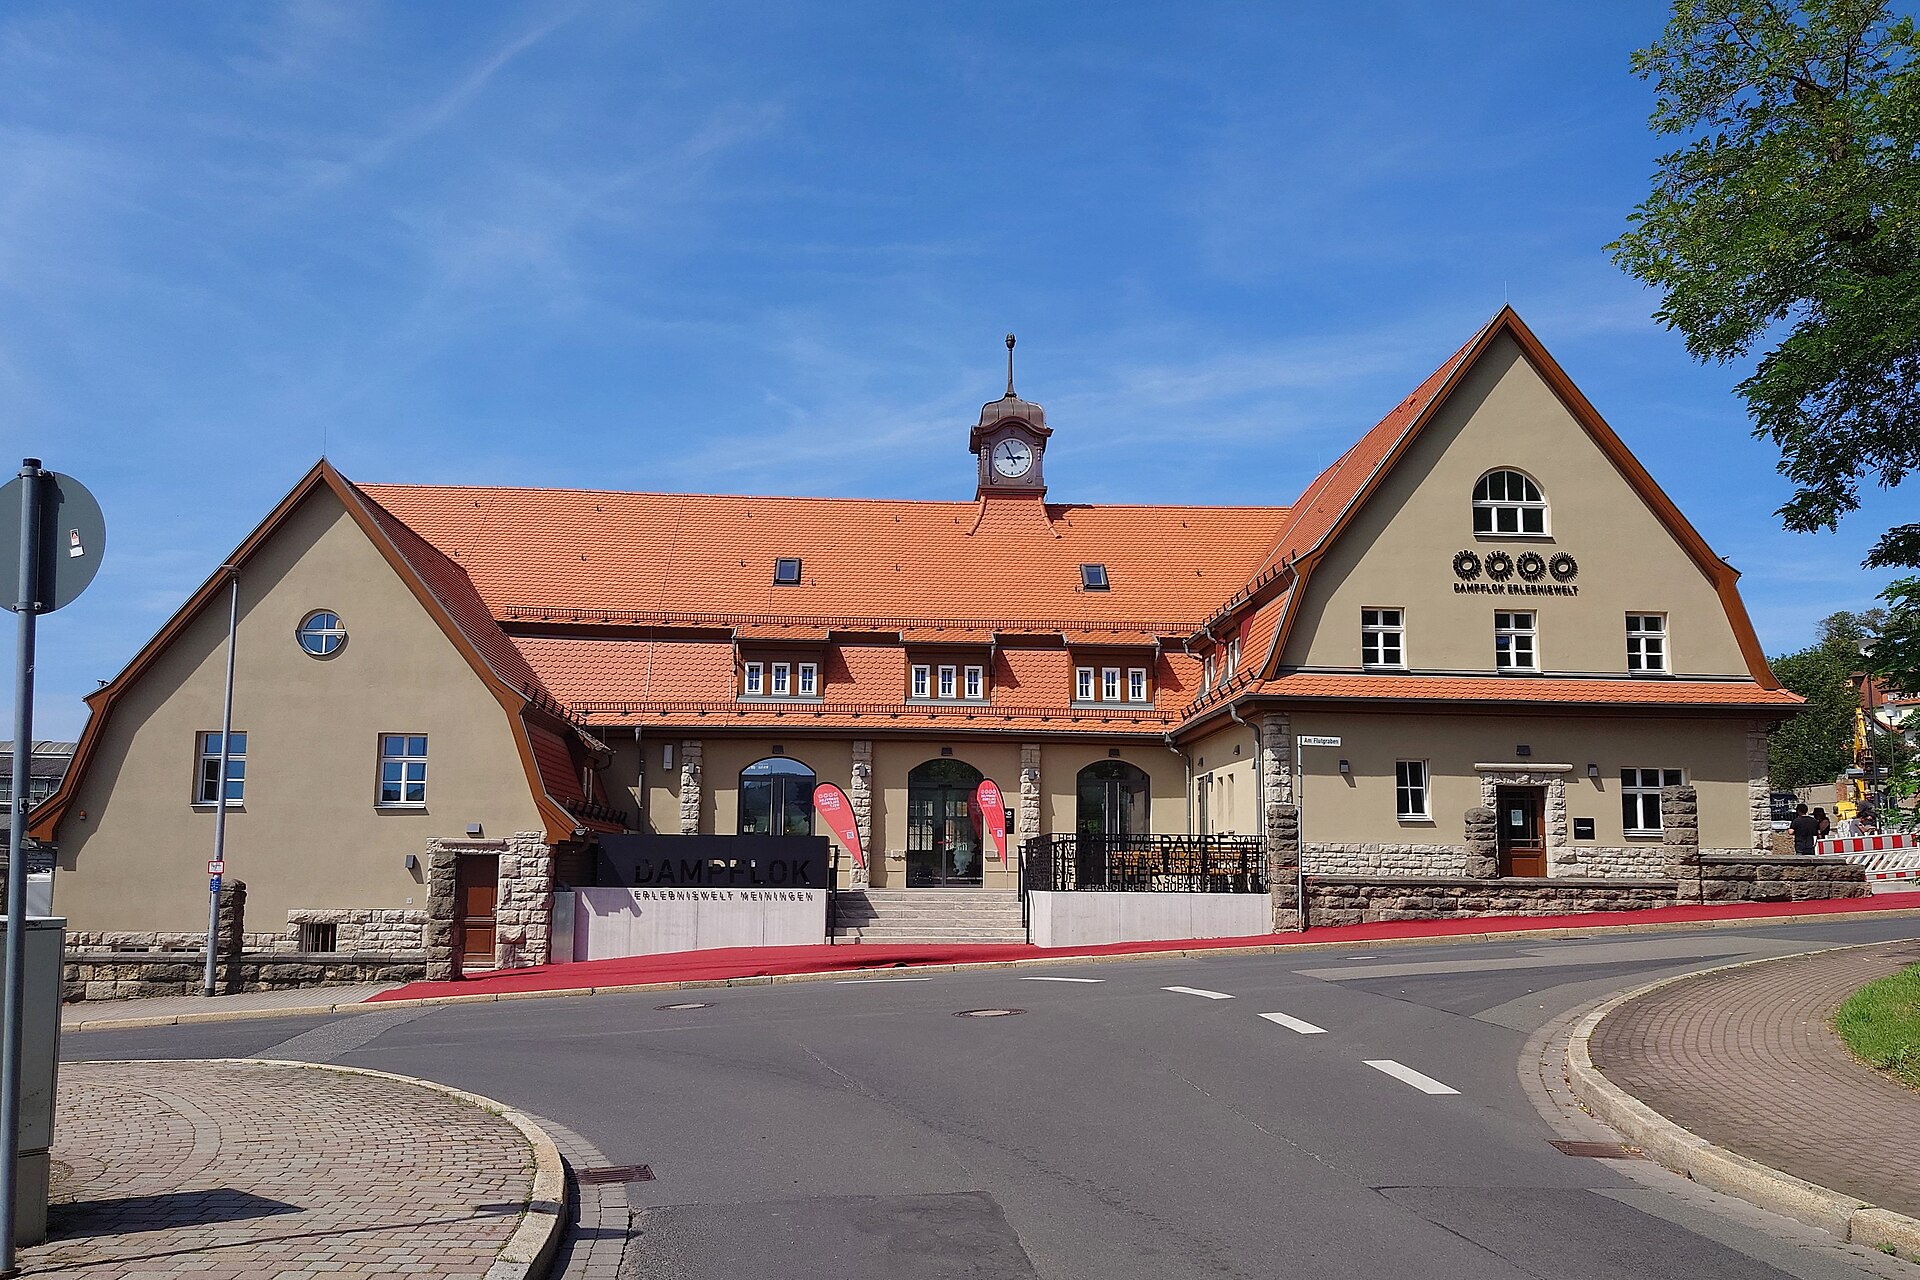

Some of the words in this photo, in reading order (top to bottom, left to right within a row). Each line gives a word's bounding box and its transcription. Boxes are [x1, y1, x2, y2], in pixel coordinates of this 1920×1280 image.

[1453, 583, 1505, 595] DAMPFLOK
[1508, 584, 1579, 596] ERLEBNISWELT
[635, 859, 811, 884] DAMPFLOK
[634, 890, 734, 901] ERLEBNISWELT
[740, 891, 813, 902] MEININGEN
